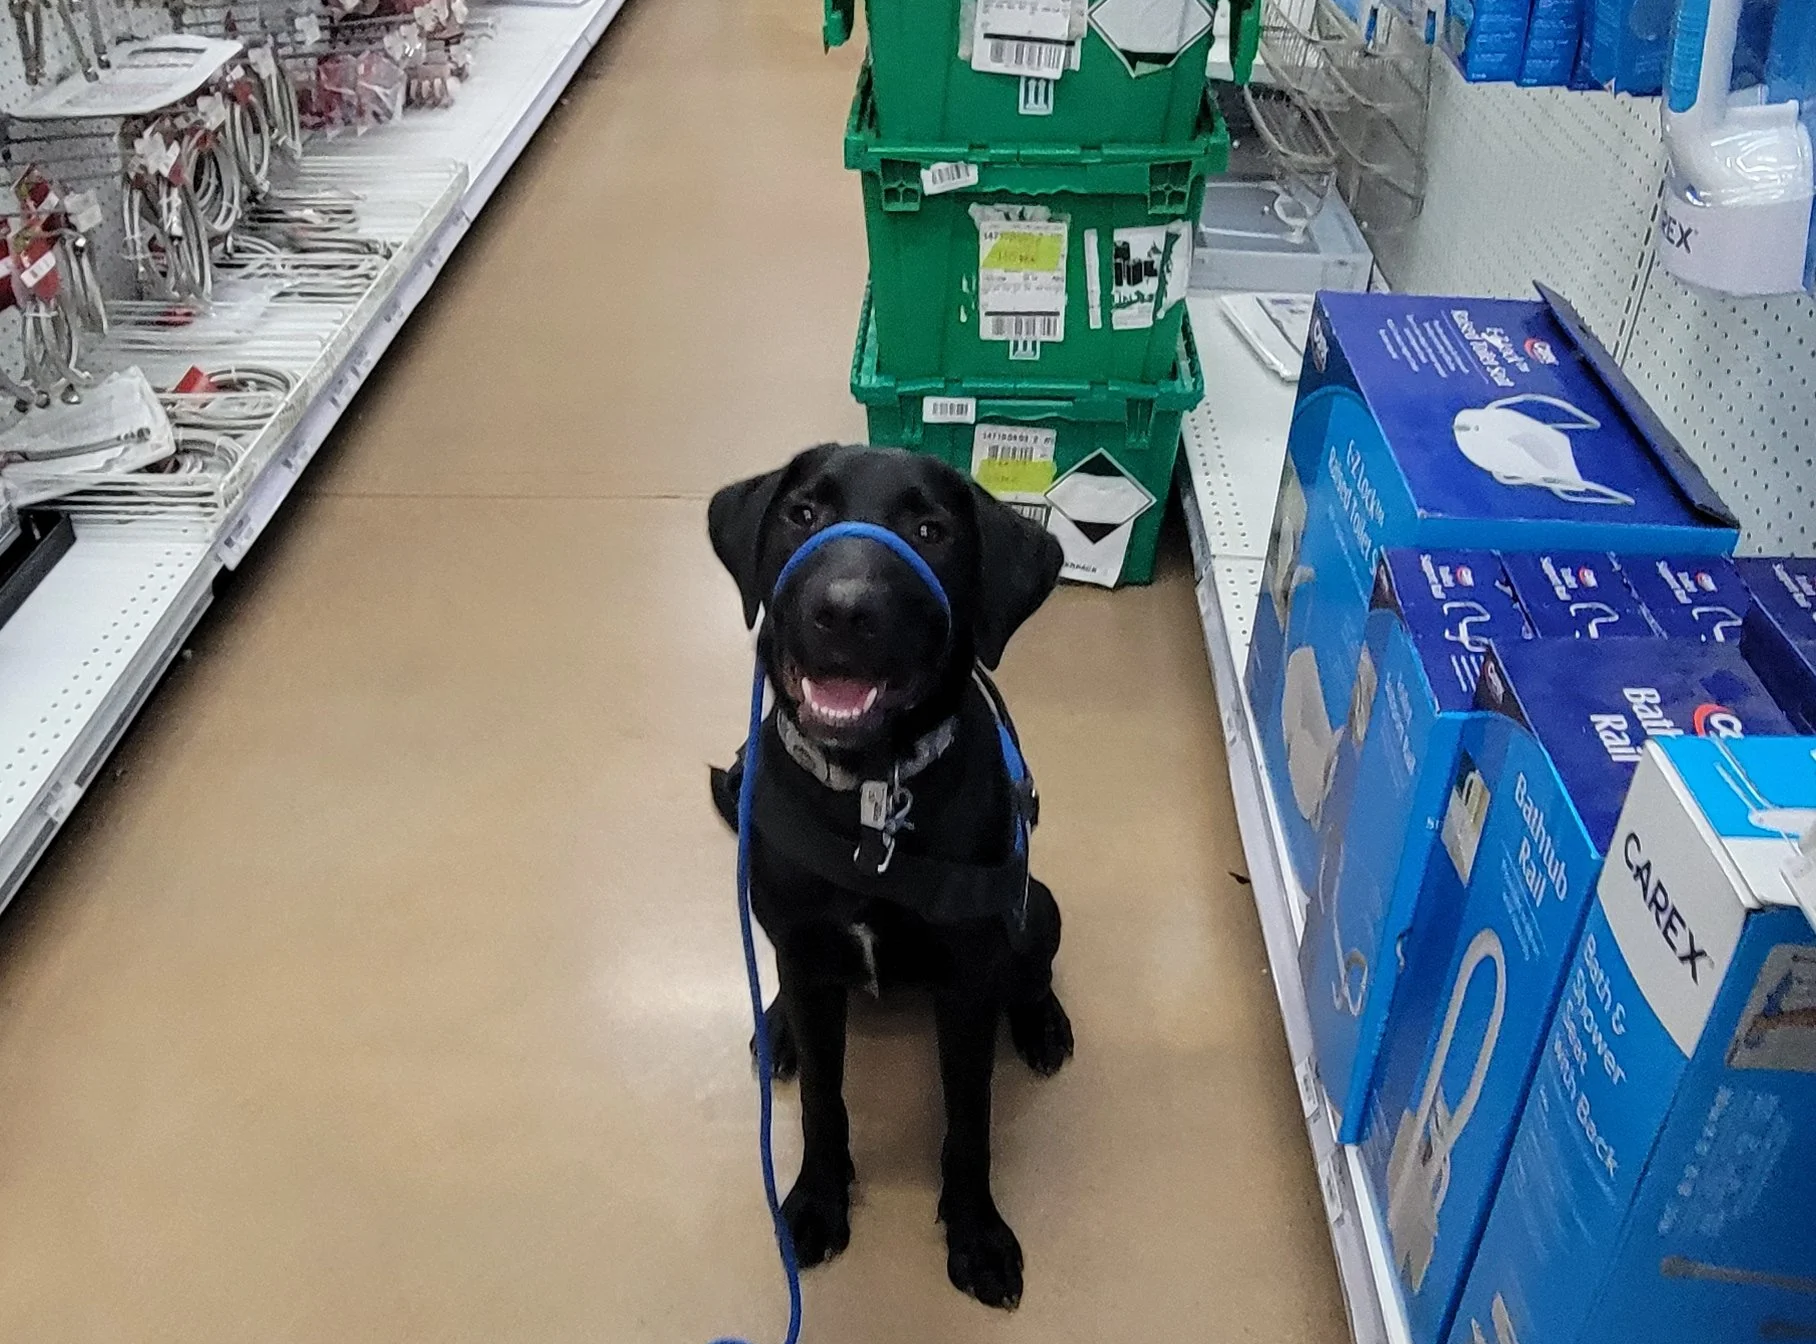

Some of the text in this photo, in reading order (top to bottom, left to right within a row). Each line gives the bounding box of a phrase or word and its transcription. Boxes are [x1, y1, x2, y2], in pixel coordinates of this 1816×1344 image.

[1590, 713, 1642, 763] Rail
[1514, 771, 1568, 902] Bathtub
[1518, 836, 1547, 908] Rail
[1624, 832, 1706, 986] CAREX
[1573, 967, 1627, 1085] Shower
[1584, 933, 1627, 1035] Bath &
[1564, 998, 1588, 1077] Seat
[1576, 1091, 1619, 1178] Back
